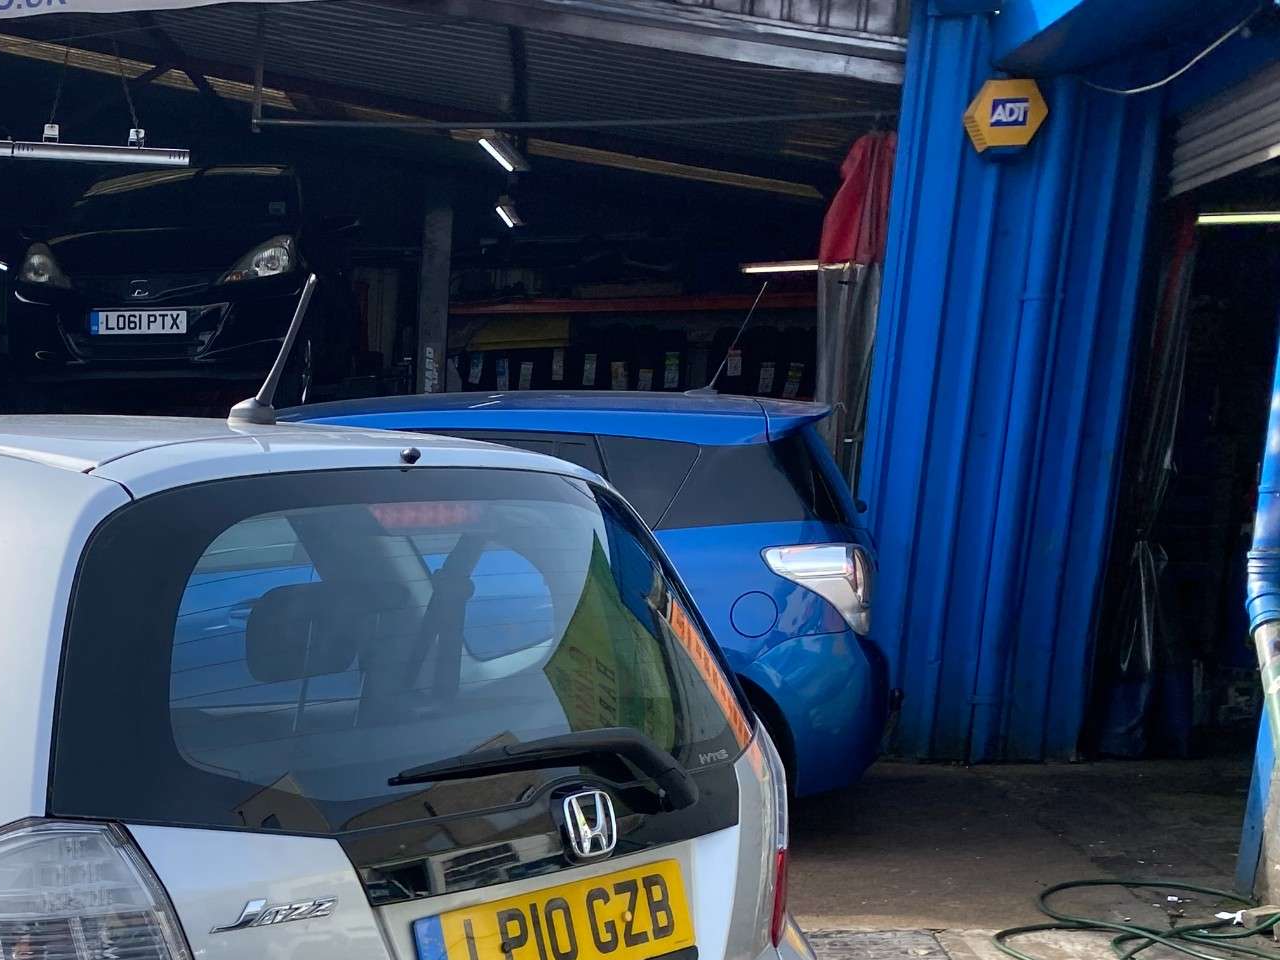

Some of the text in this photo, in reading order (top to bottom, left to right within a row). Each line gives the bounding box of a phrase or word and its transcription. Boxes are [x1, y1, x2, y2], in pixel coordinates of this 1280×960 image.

[991, 102, 1029, 122] ADT
[105, 313, 180, 331] LO61 PTX
[586, 873, 675, 954] GZB
